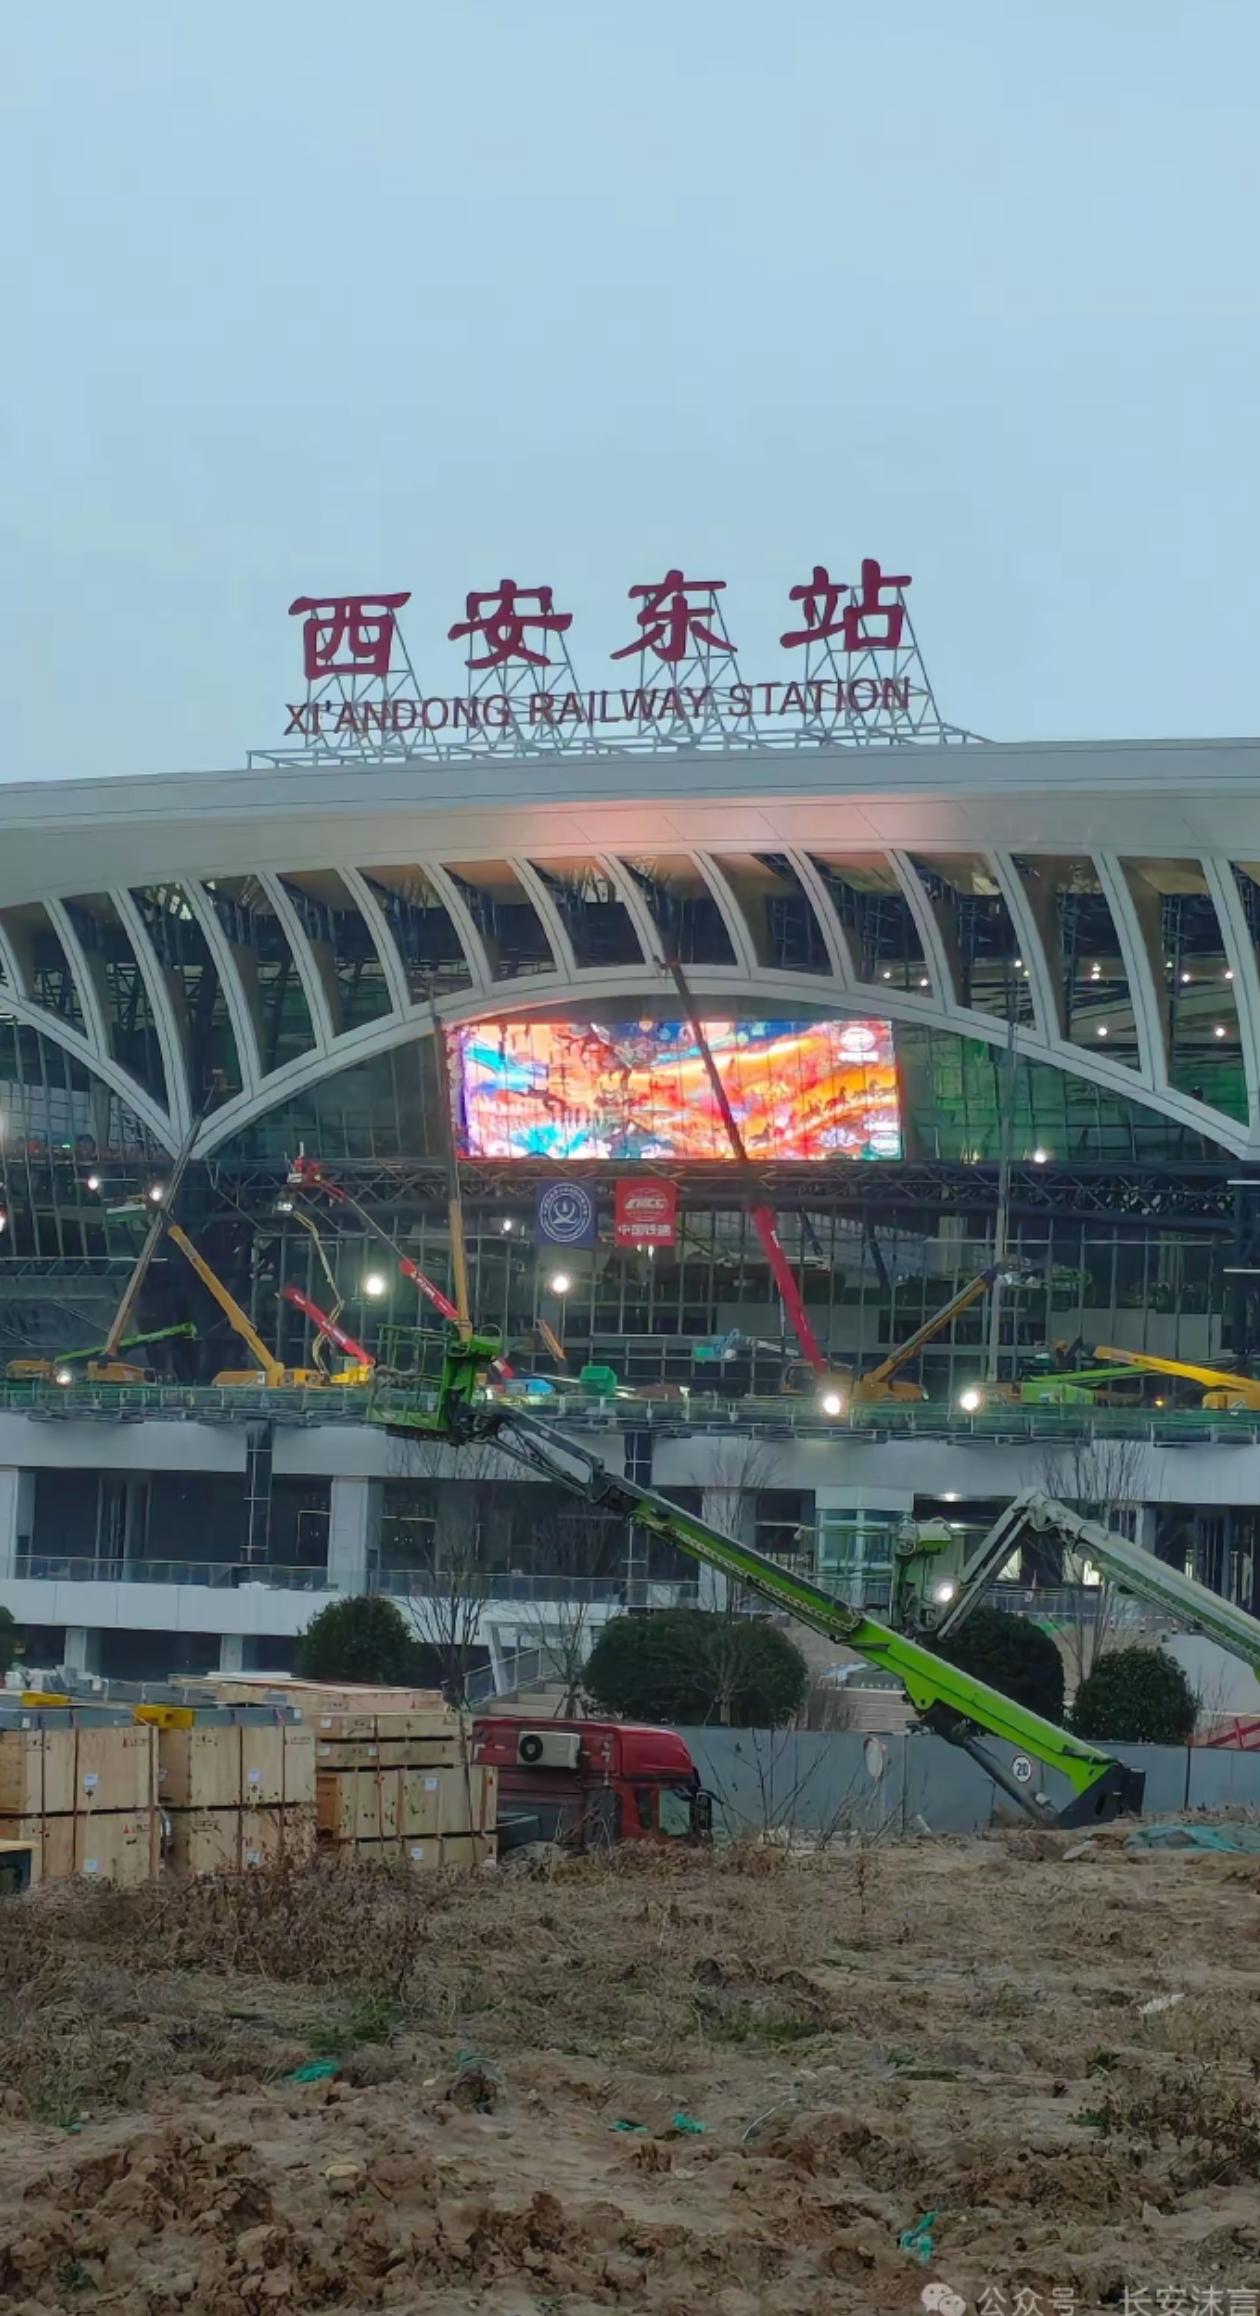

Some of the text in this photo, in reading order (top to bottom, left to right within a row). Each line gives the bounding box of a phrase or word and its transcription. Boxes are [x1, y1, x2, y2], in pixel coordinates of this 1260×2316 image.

[288, 558, 912, 681] 西安东站
[284, 676, 910, 735] XI'ANDONG RAILWAY STATION
[1016, 1762, 1028, 1776] 20
